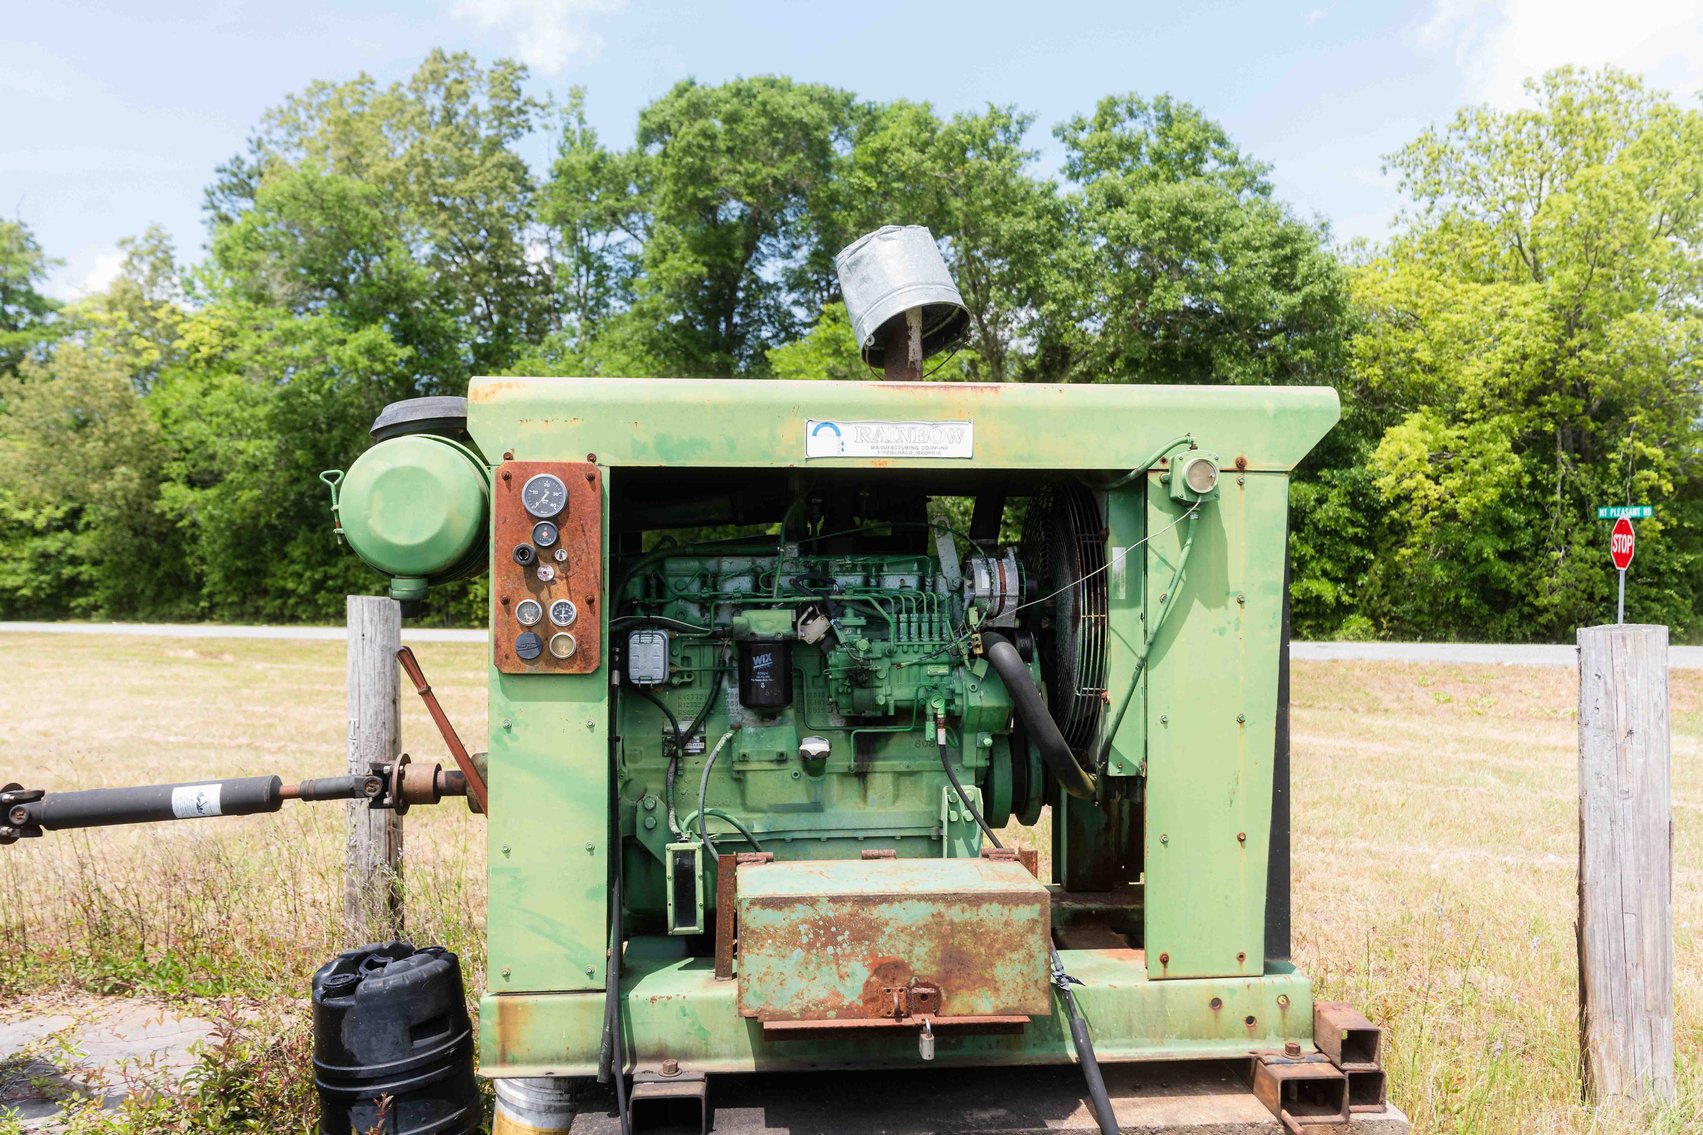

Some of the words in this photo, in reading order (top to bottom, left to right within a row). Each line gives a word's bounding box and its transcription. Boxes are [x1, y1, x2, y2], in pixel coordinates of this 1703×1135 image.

[854, 425, 965, 444] RAINBOW
[1610, 507, 1641, 517] PLEASANT
[1612, 533, 1633, 554] STOP
[752, 652, 772, 666] WIX
